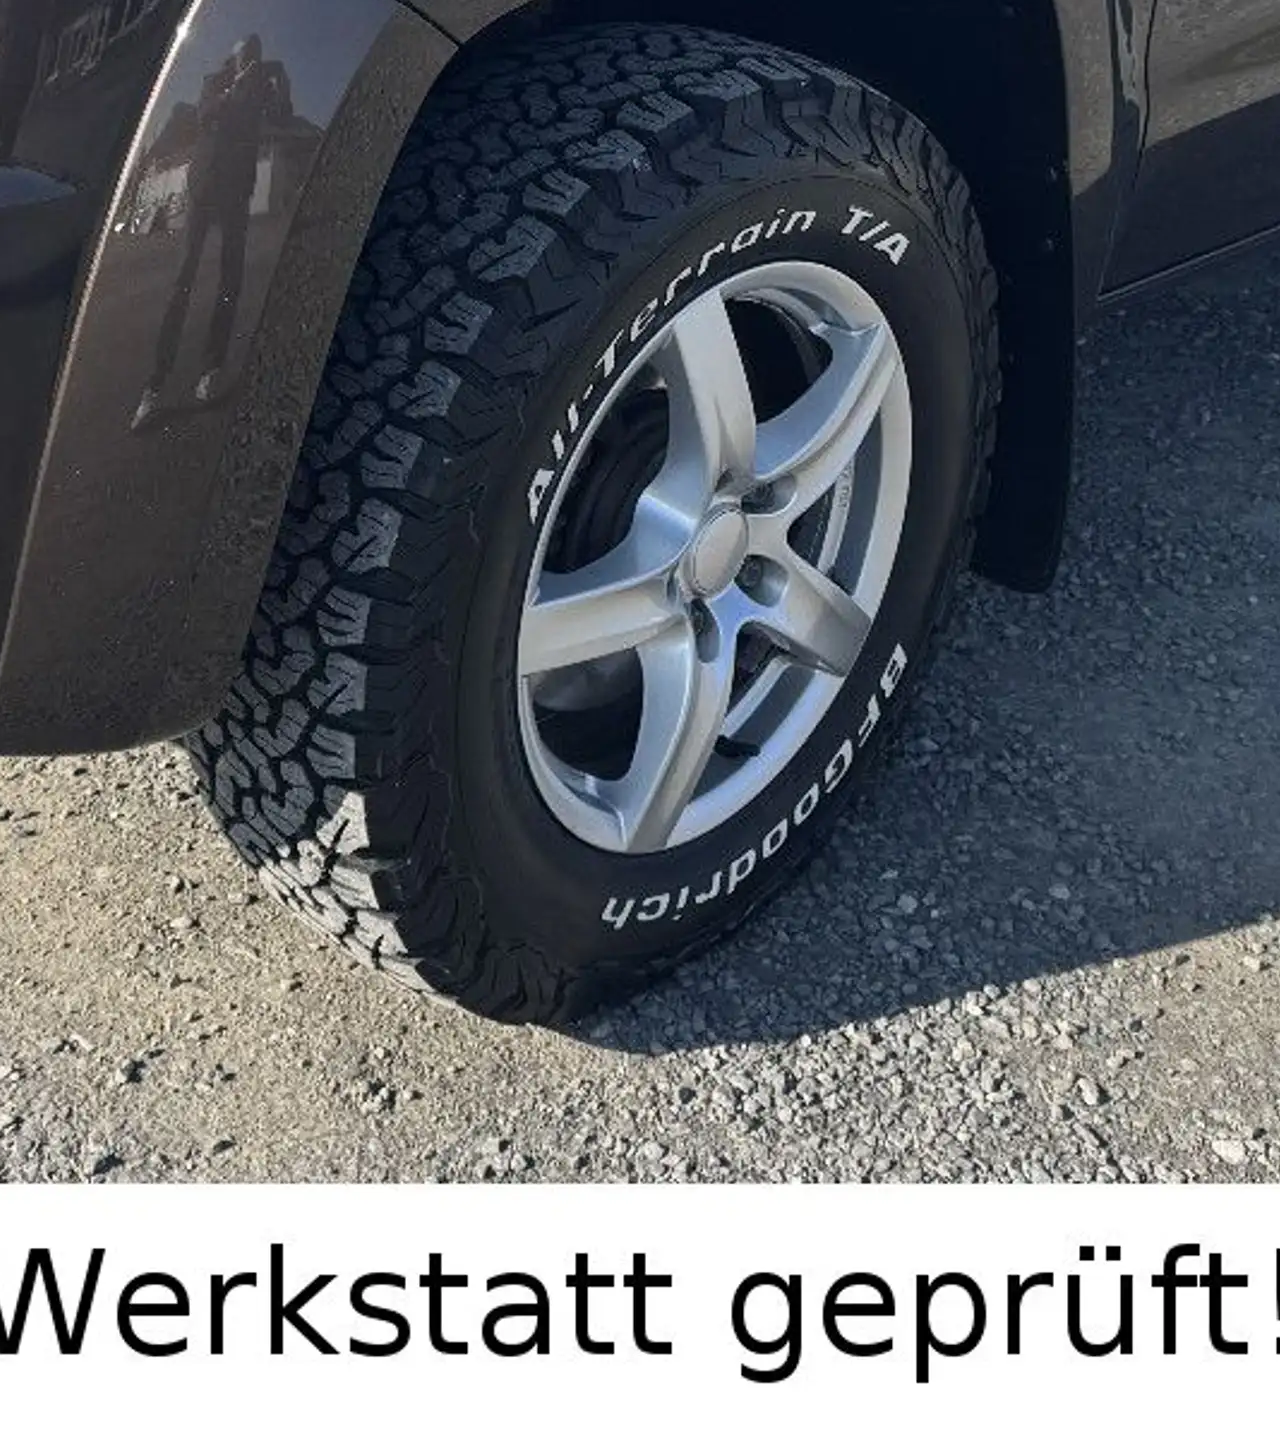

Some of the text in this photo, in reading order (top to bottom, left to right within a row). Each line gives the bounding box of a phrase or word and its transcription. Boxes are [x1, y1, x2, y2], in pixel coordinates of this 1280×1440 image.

[527, 205, 912, 525] All-Terrain T/A
[601, 642, 908, 931] BFGoodrich
